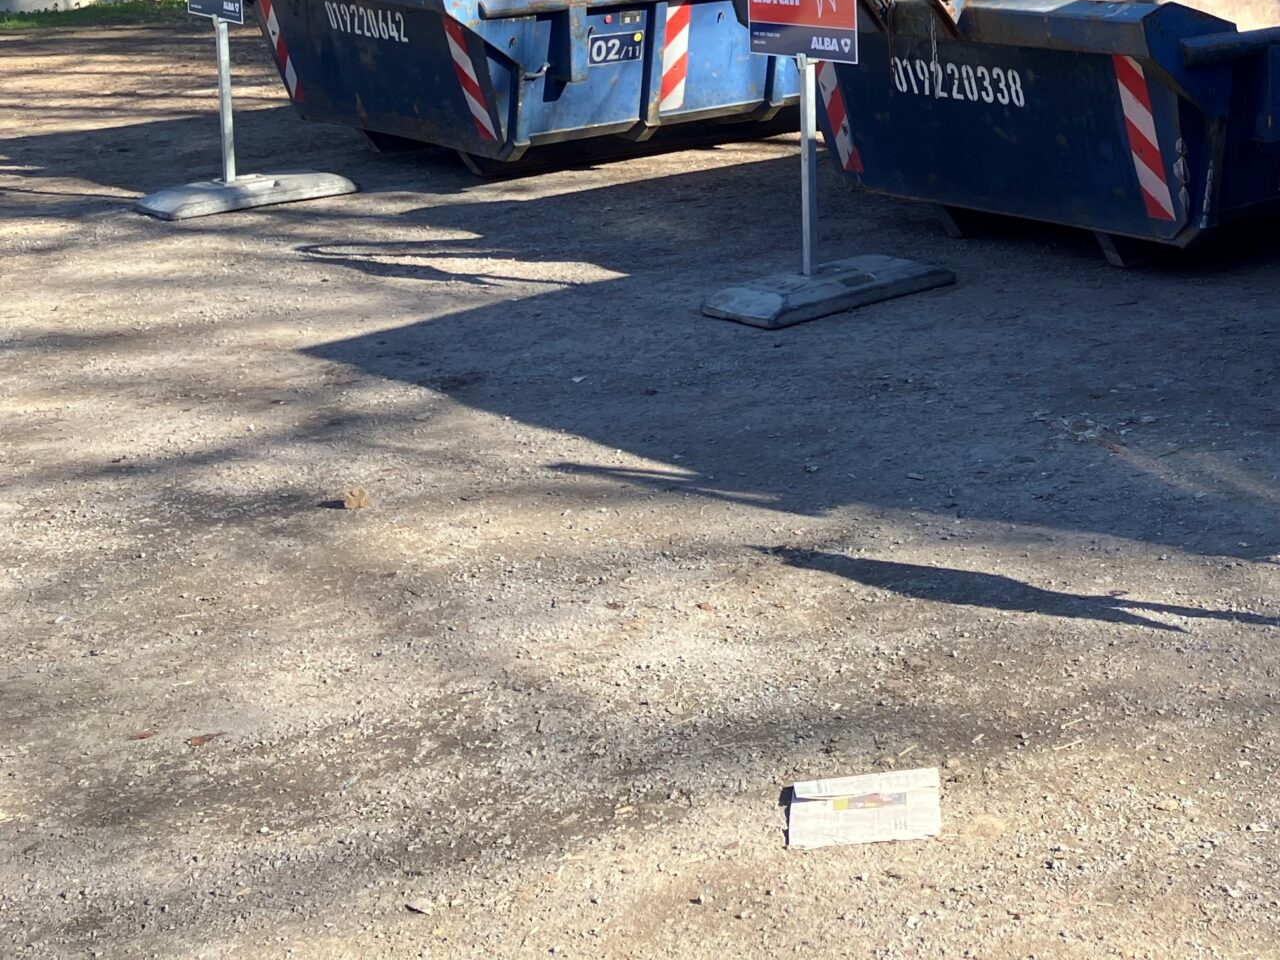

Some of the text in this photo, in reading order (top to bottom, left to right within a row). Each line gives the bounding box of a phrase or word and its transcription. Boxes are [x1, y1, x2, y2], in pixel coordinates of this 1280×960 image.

[324, 0, 409, 43] 019220642
[591, 38, 640, 62] 02/11
[810, 36, 839, 52] ALBA
[891, 56, 1025, 108] 019220338
